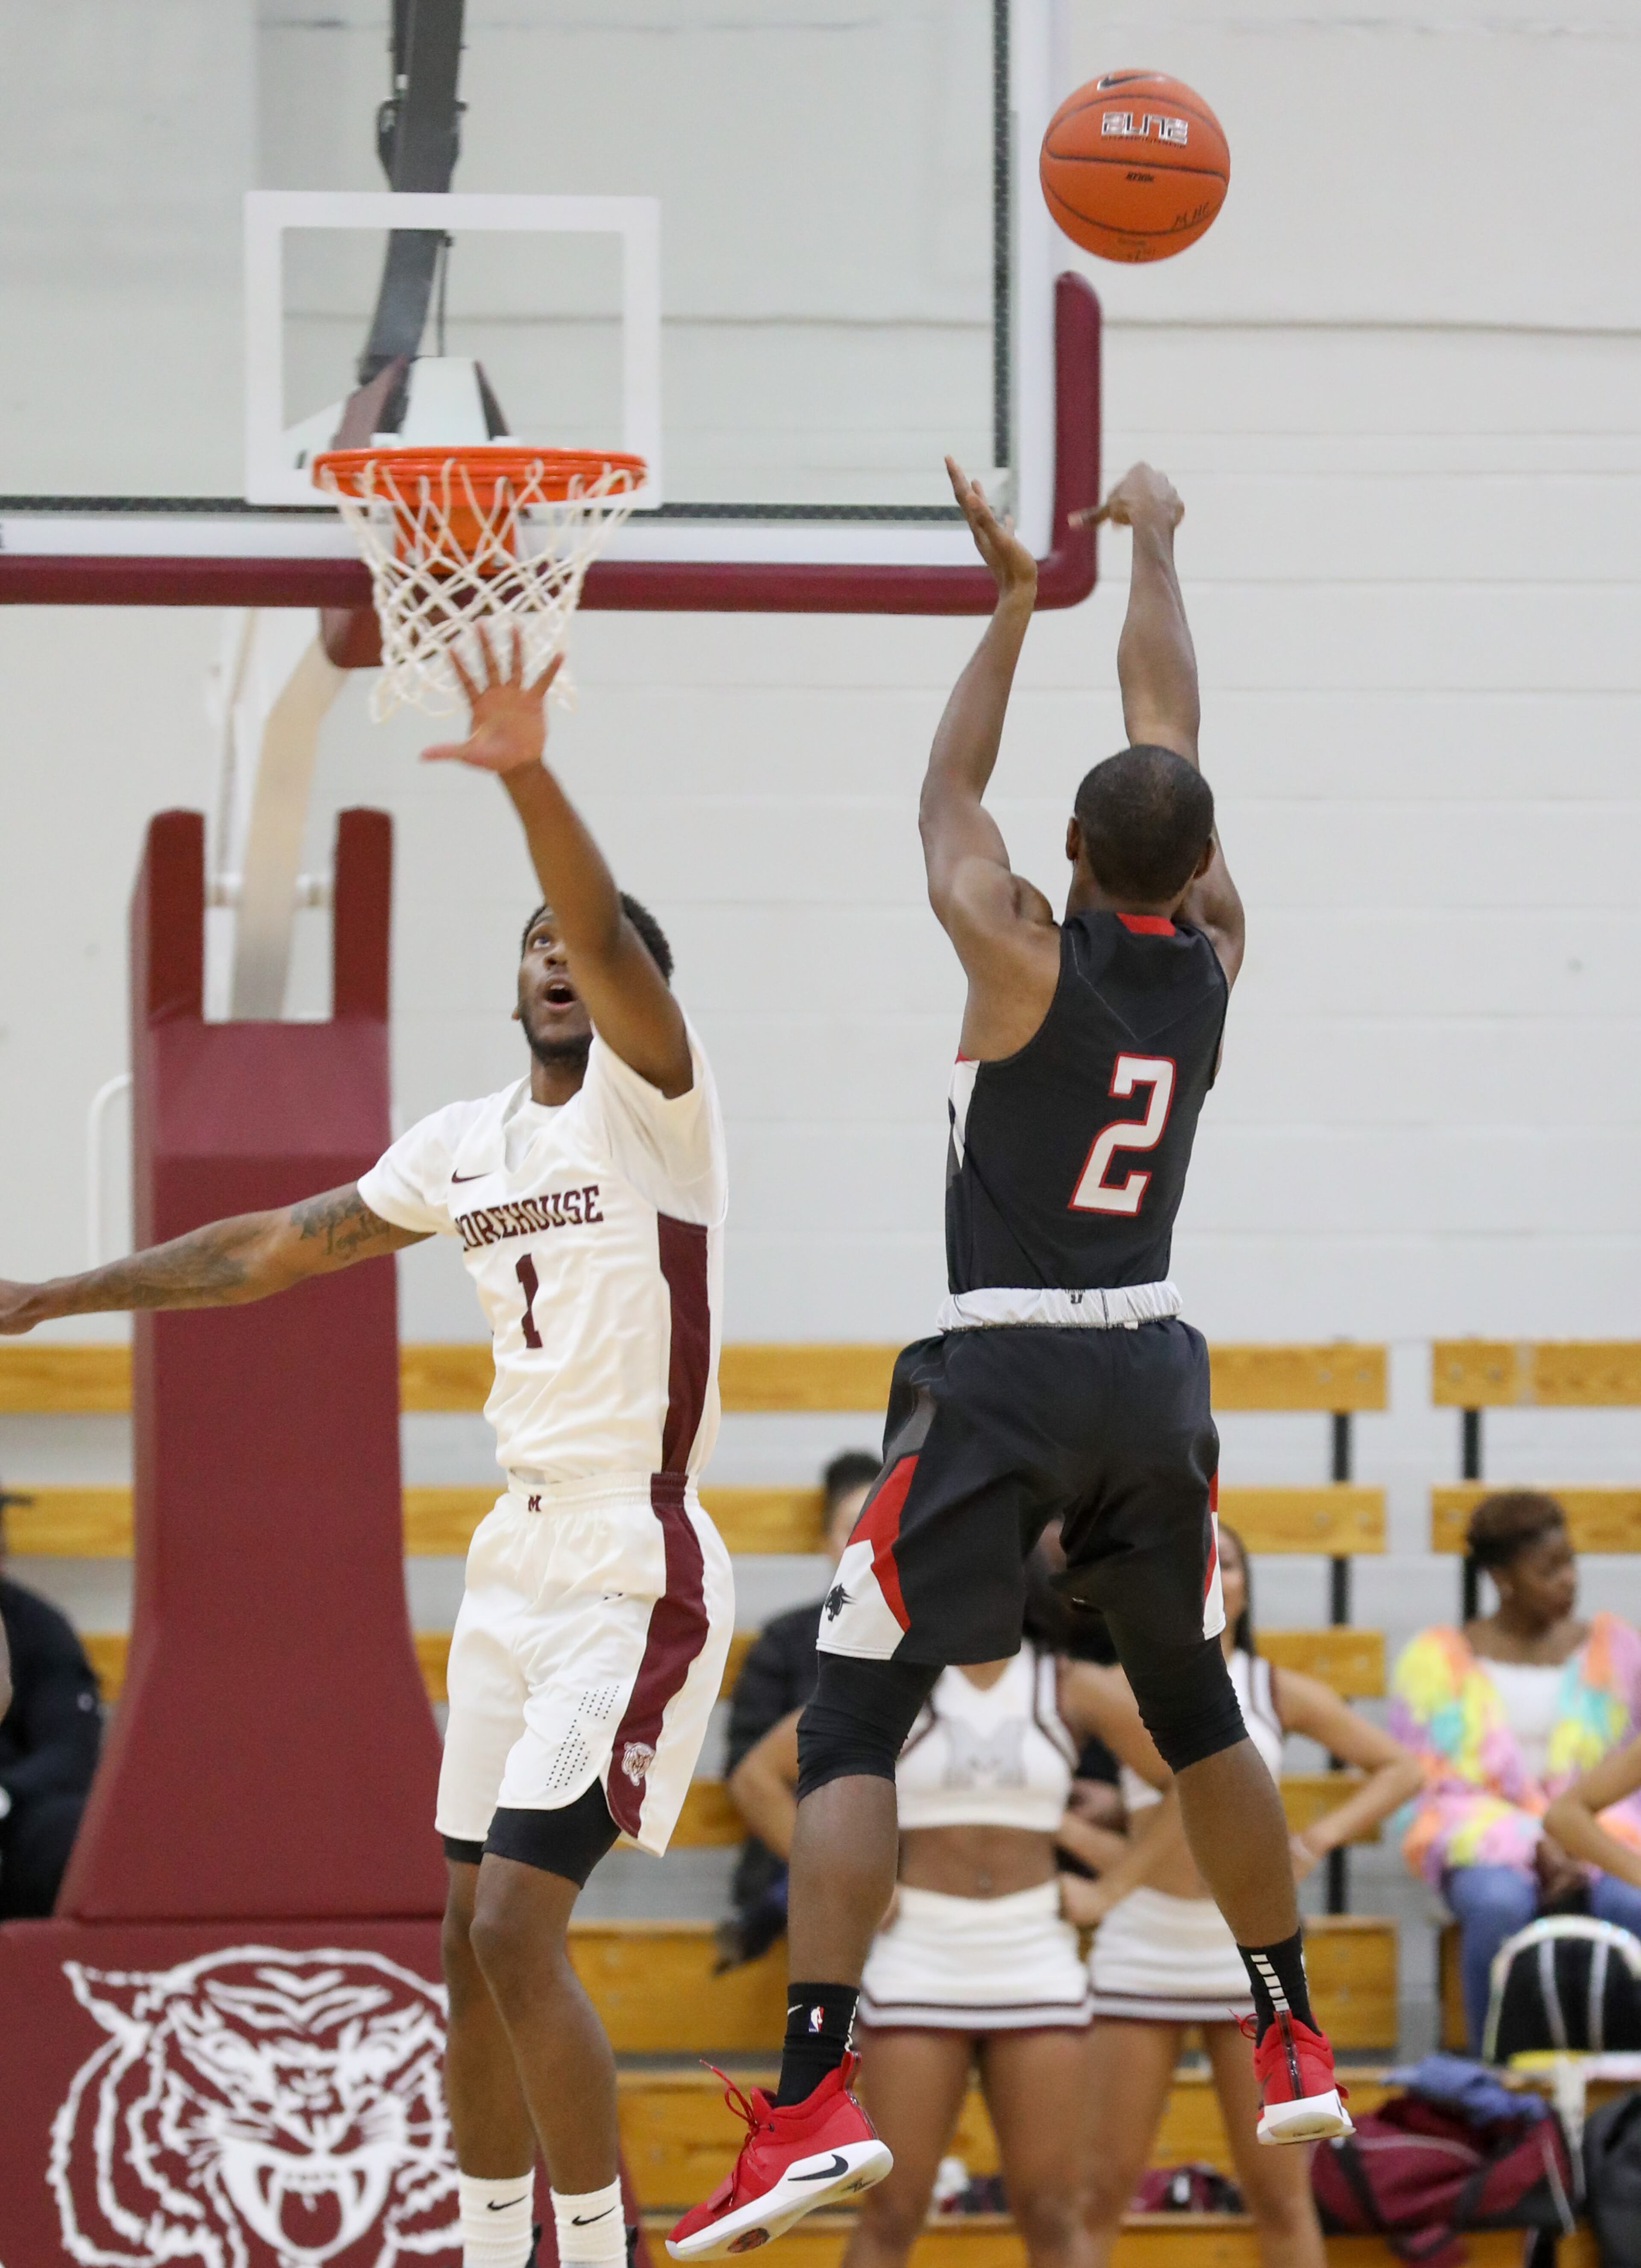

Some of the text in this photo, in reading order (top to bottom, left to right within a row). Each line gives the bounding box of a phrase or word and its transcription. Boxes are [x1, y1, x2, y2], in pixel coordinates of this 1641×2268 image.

[1101, 112, 1188, 144] ELITE
[1068, 1051, 1176, 1216] 2
[455, 1185, 603, 1252] OREHOUSE
[515, 1252, 543, 1349] 1
